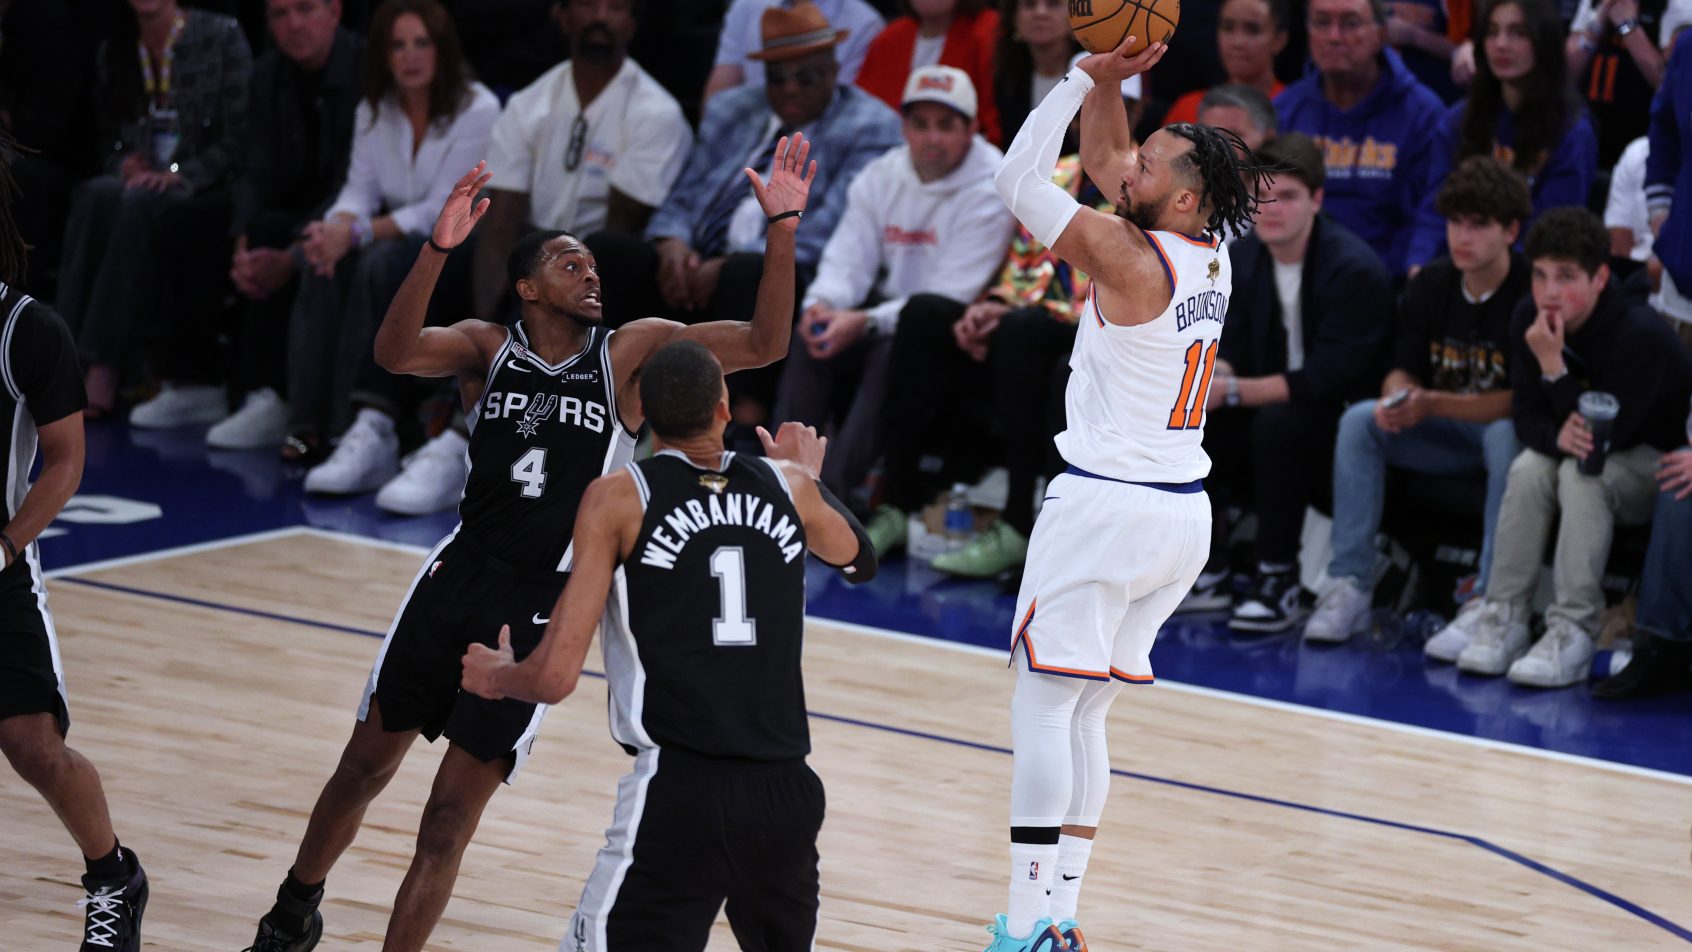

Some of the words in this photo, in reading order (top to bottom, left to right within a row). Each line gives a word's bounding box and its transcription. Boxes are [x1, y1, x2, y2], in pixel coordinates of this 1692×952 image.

[1175, 290, 1228, 332] BRUNSON
[484, 392, 606, 439] SPURS
[1166, 338, 1218, 430] 11
[510, 446, 548, 498] 4
[640, 493, 803, 570] WEMBANYAMA
[709, 546, 757, 646] 1
